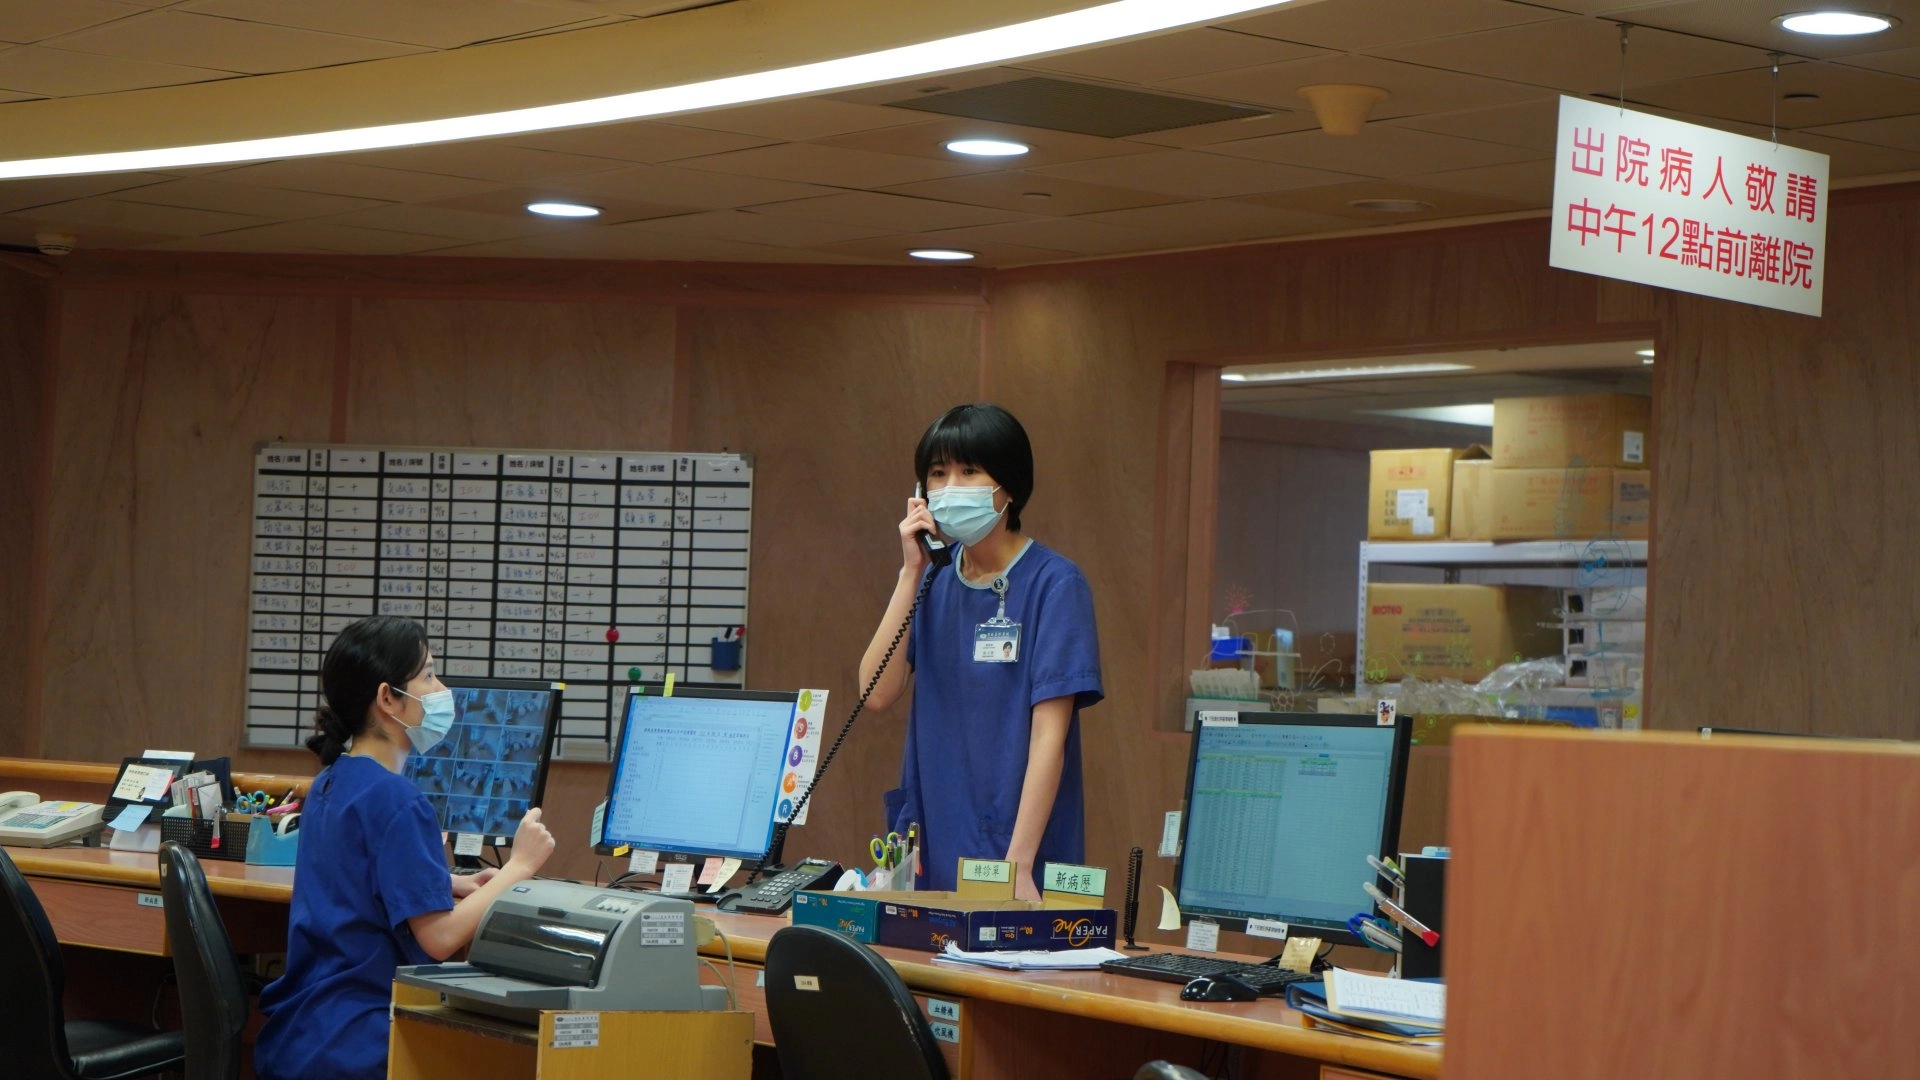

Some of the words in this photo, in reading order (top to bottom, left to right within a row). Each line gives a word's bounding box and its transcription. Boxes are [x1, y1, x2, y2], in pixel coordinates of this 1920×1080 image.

[1571, 127, 1817, 223] 出院病人敬請
[1567, 197, 1814, 289] 中午12點前離院
[973, 863, 1001, 878] 轉診單
